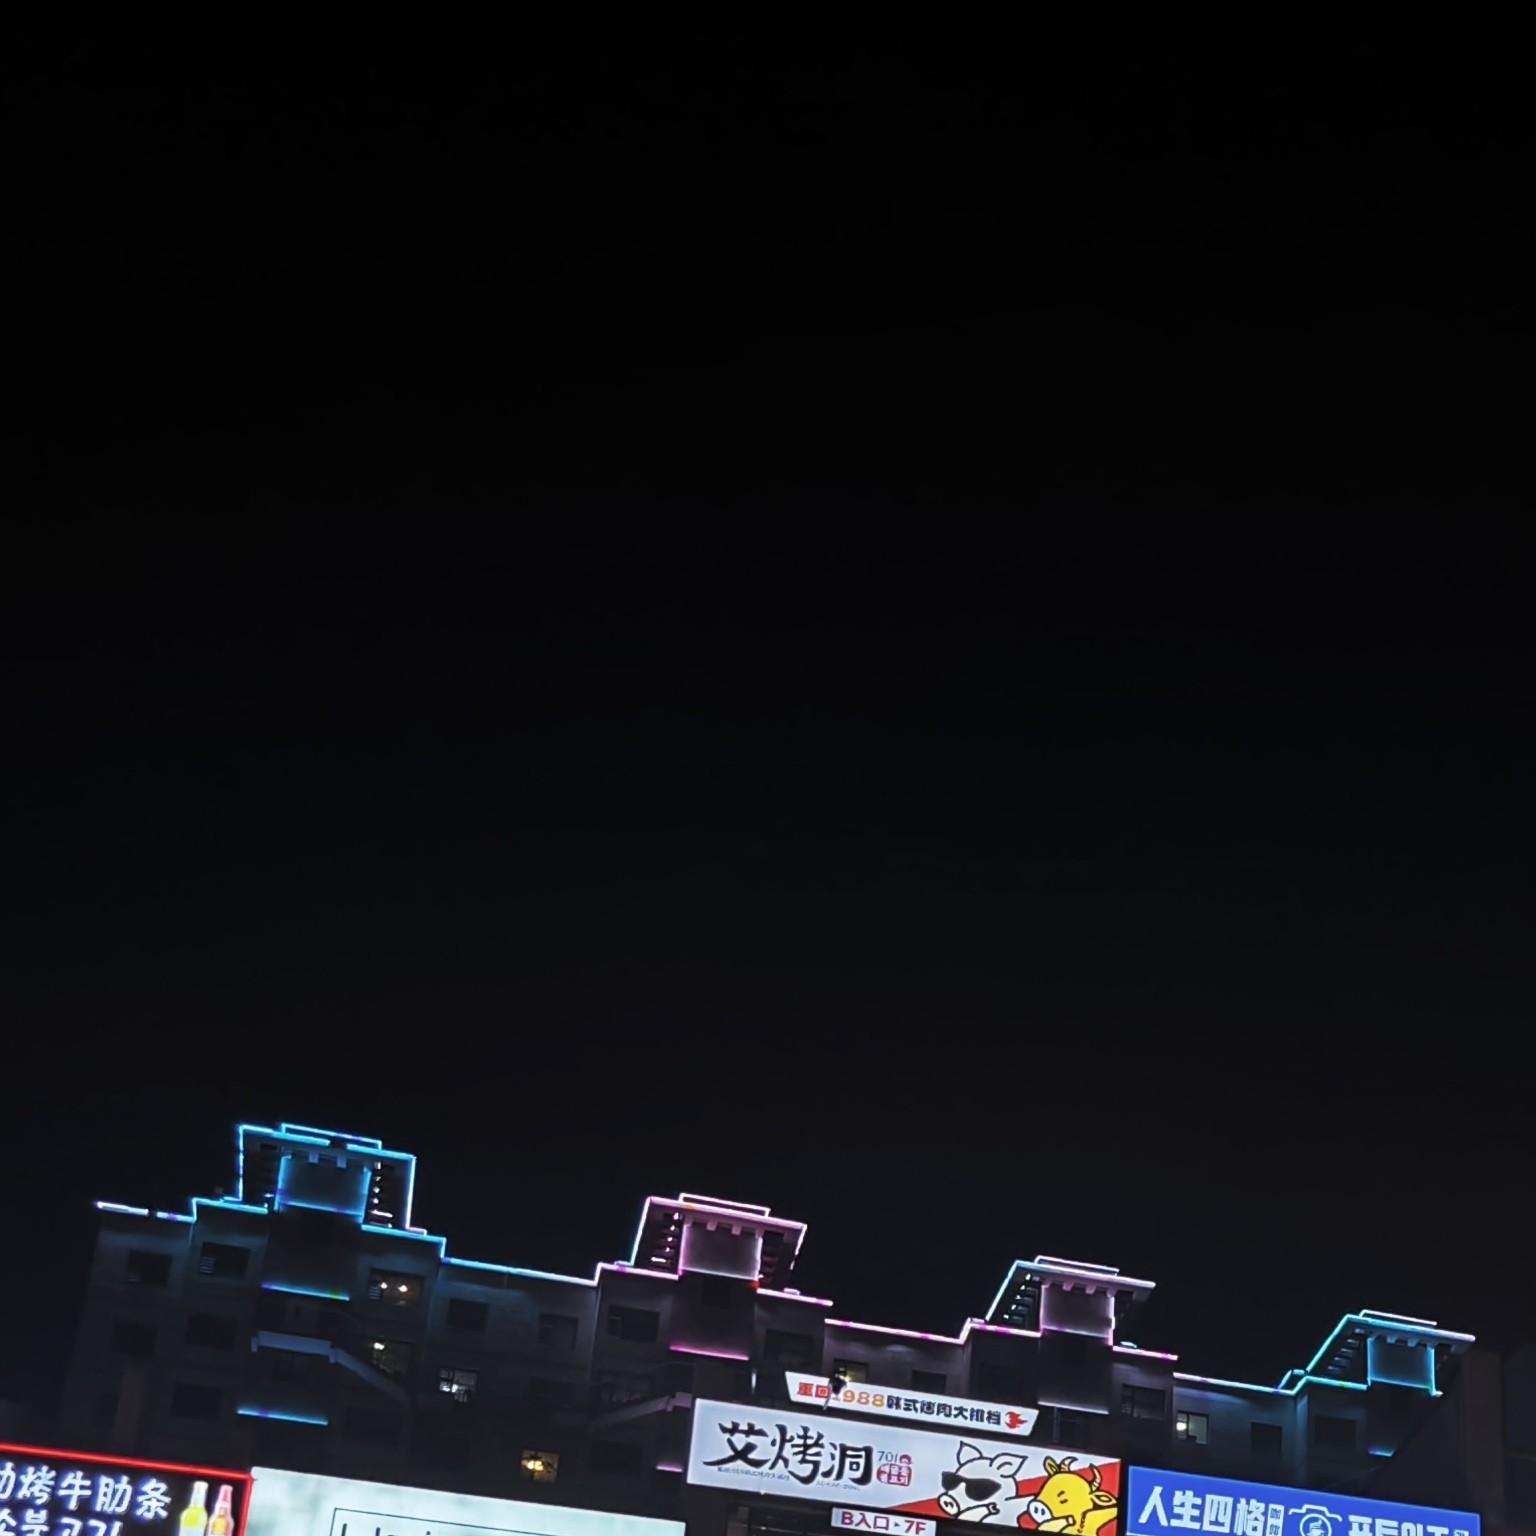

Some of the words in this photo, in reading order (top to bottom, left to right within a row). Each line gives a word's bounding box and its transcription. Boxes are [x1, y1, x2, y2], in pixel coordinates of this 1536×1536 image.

[702, 1420, 874, 1486] 艾烤洞
[840, 1510, 890, 1531] B入口
[904, 1519, 927, 1535] 7F
